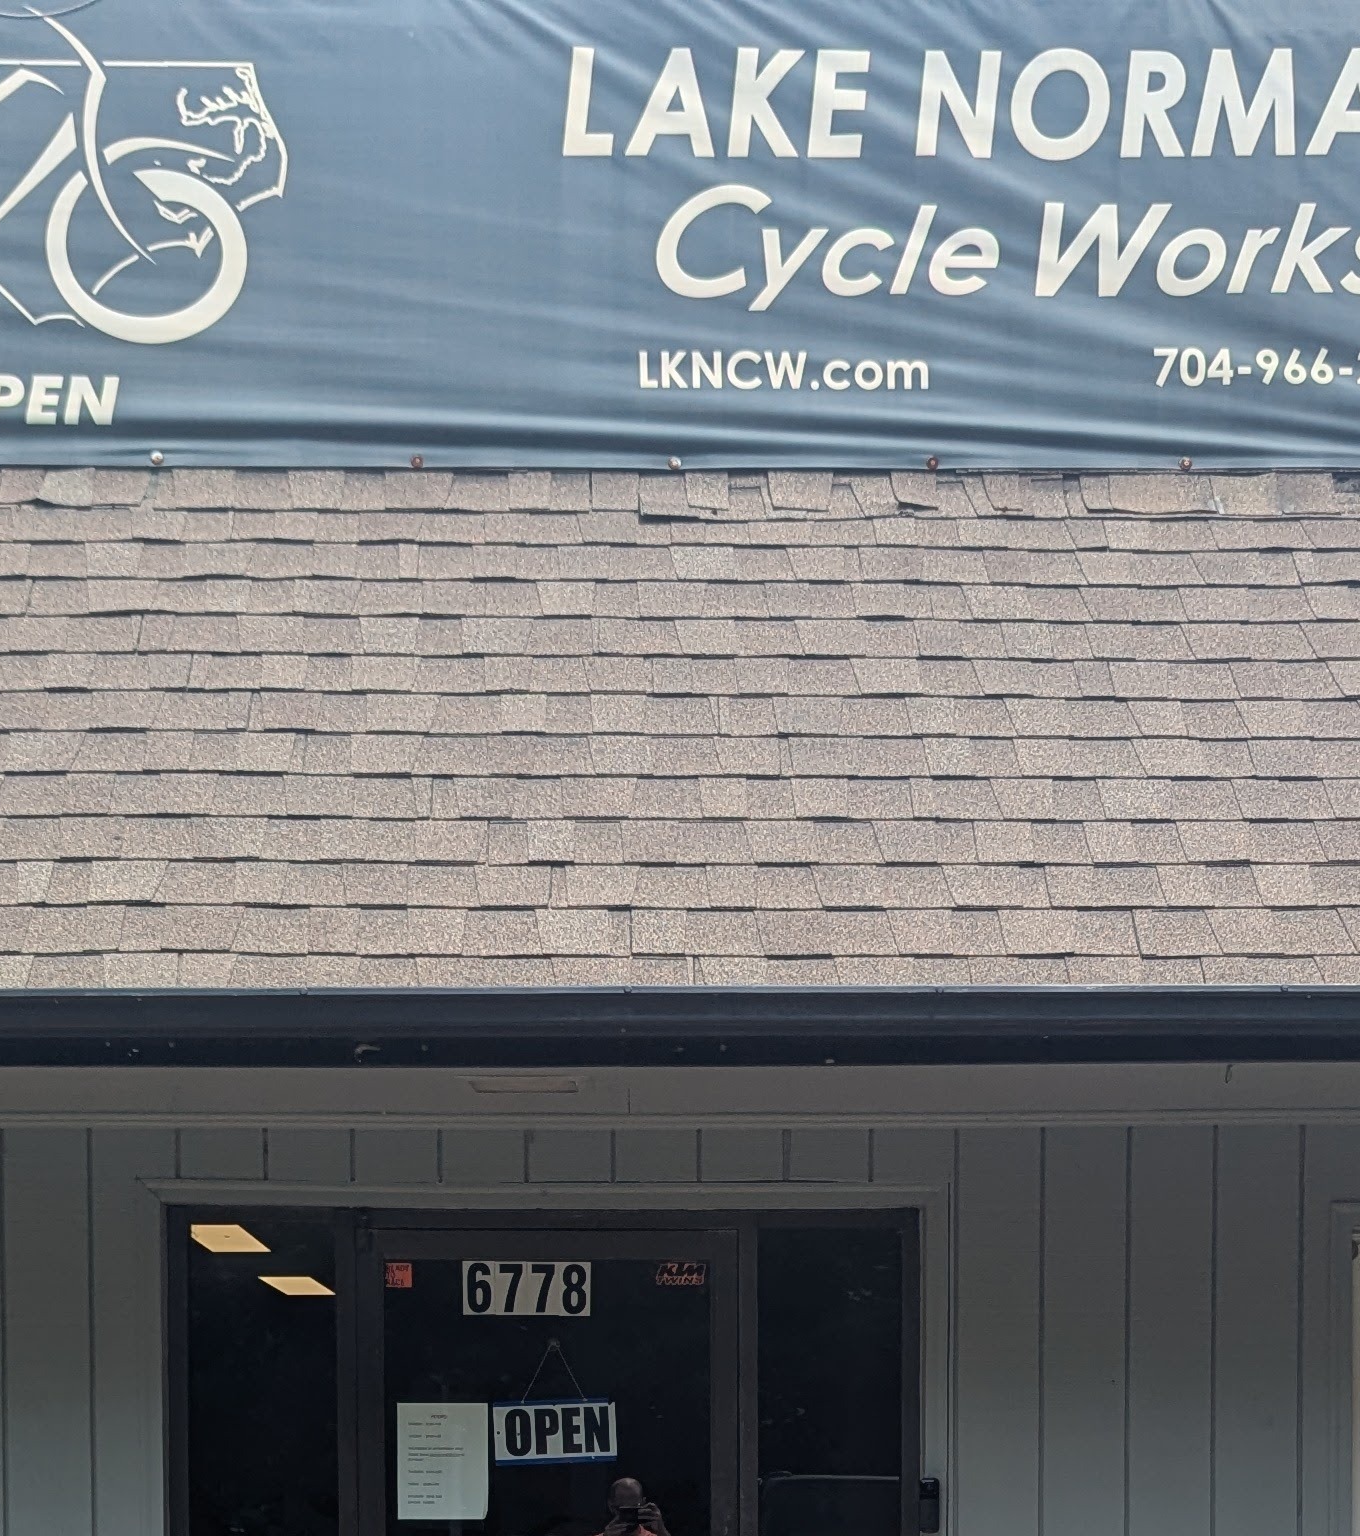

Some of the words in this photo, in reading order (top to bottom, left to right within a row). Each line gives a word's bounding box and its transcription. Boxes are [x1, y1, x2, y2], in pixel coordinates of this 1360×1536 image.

[563, 47, 870, 158] LAKE
[656, 185, 1000, 311] Cycle
[639, 350, 929, 390] LKNCW.com
[467, 1262, 587, 1315] 6778
[505, 1405, 611, 1457] OPEN
